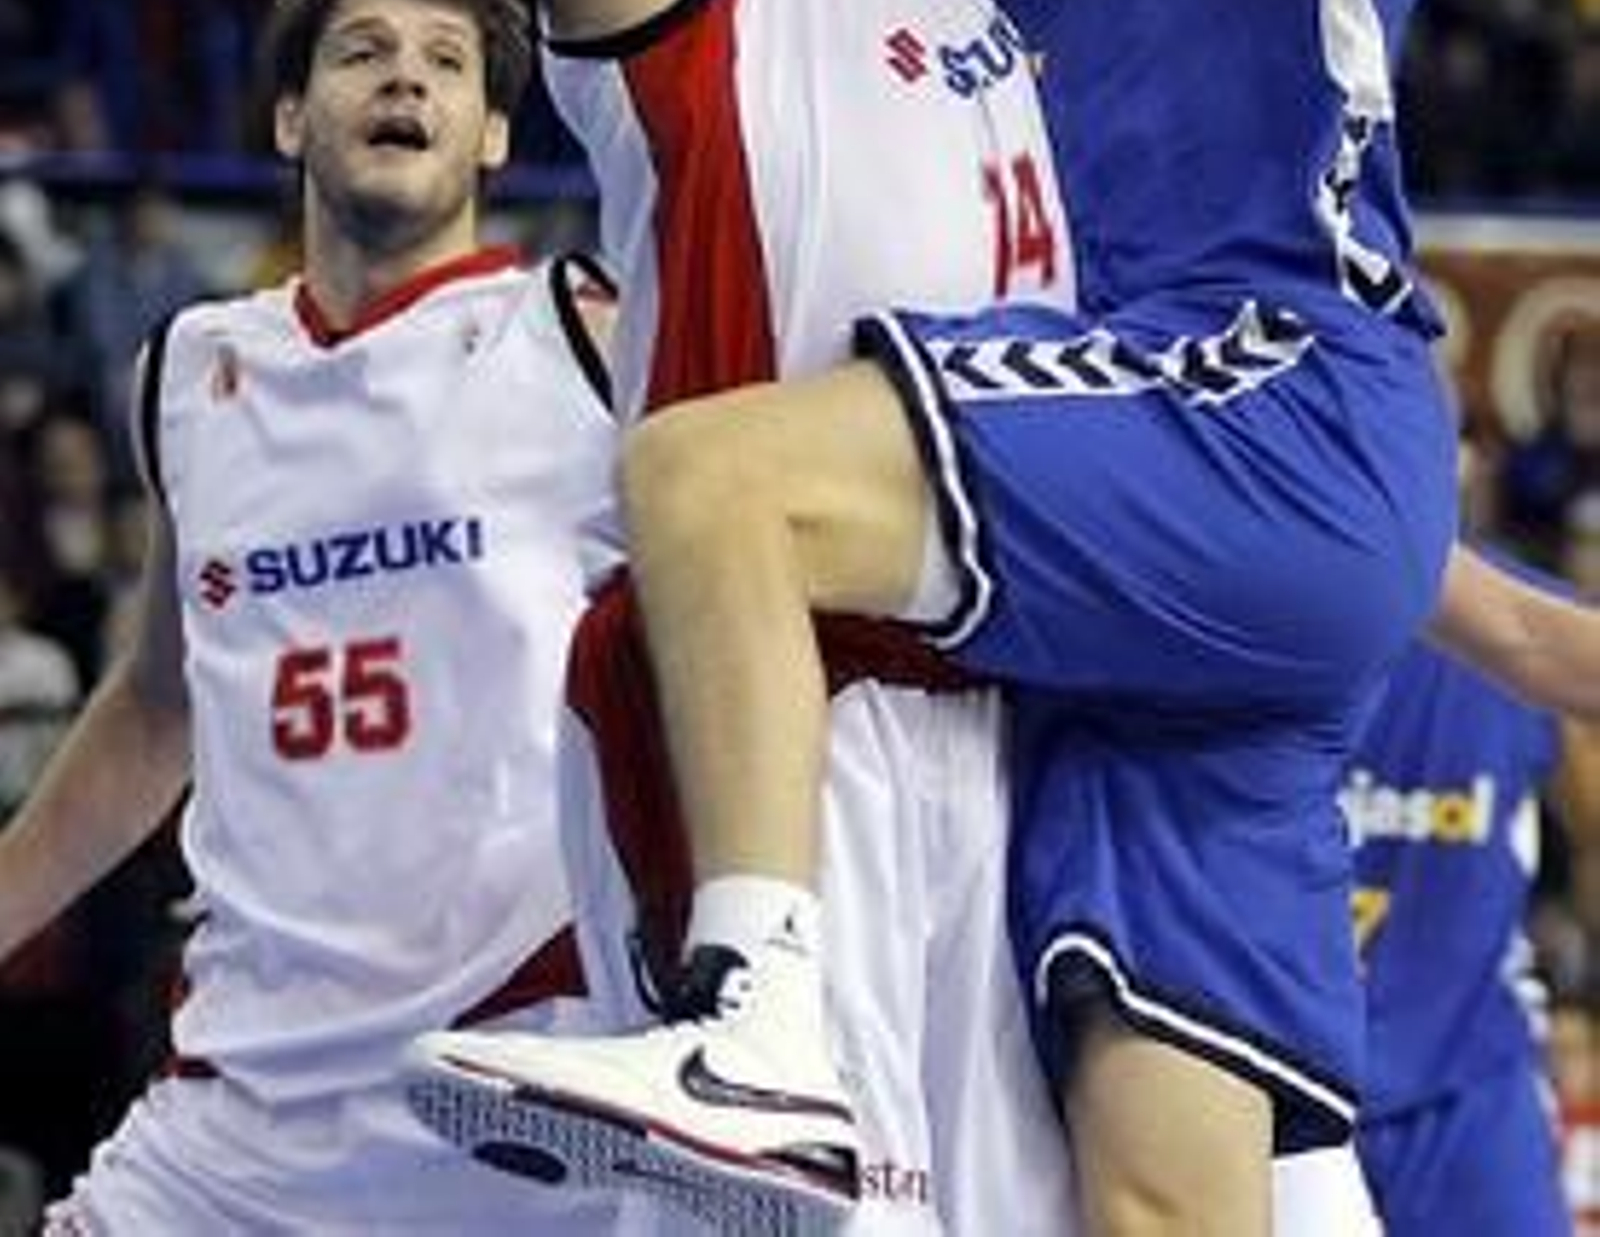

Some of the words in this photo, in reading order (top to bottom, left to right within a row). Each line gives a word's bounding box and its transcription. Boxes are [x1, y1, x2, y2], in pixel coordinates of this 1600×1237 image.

[981, 150, 1056, 298] 14
[245, 518, 483, 595] SUZUKI
[271, 634, 411, 761] 55
